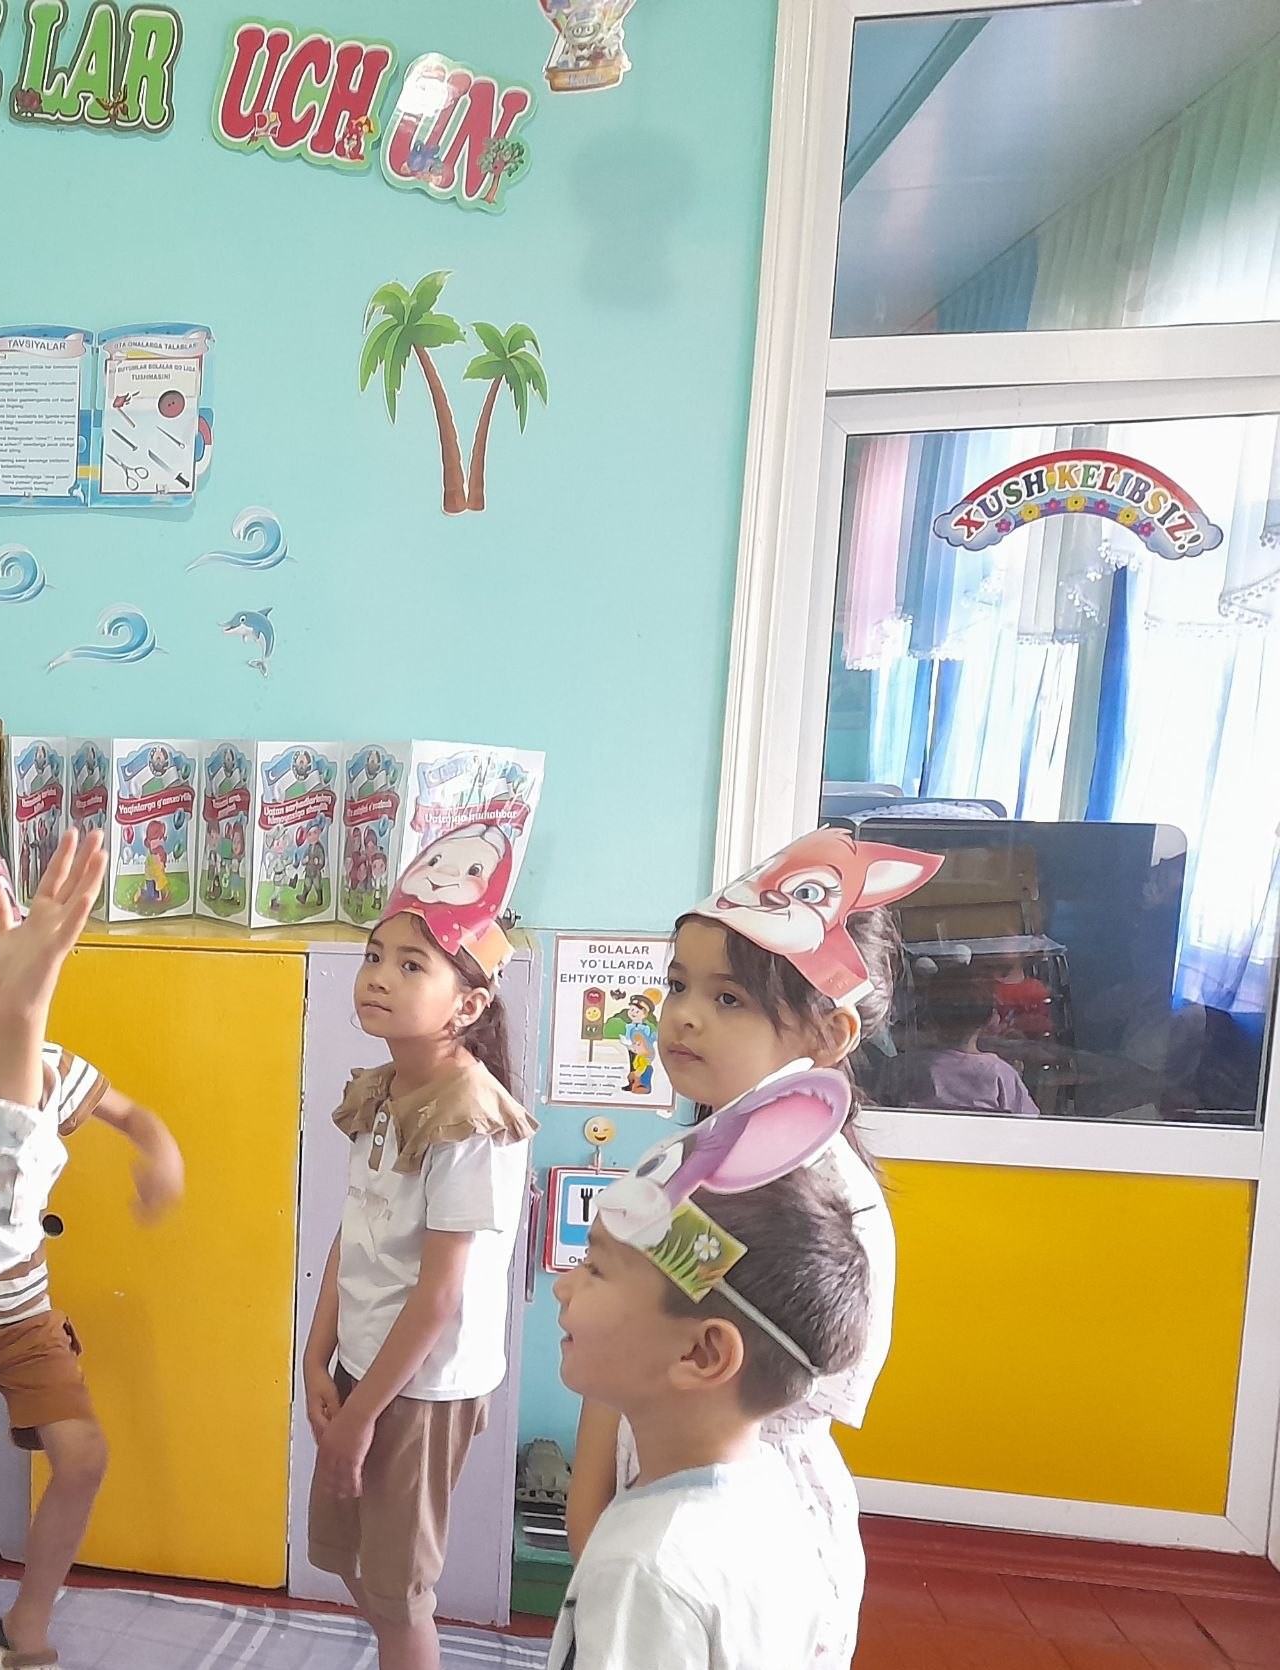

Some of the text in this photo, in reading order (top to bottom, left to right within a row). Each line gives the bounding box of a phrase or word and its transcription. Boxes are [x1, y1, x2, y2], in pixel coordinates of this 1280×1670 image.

[8, 340, 66, 350] TAVSIYALAR
[953, 462, 1202, 551] XUSH KELIBSIZ!
[119, 803, 156, 815] Yaqinlarga
[588, 944, 650, 955] BOLALAR
[560, 973, 614, 984] EHTIYOT
